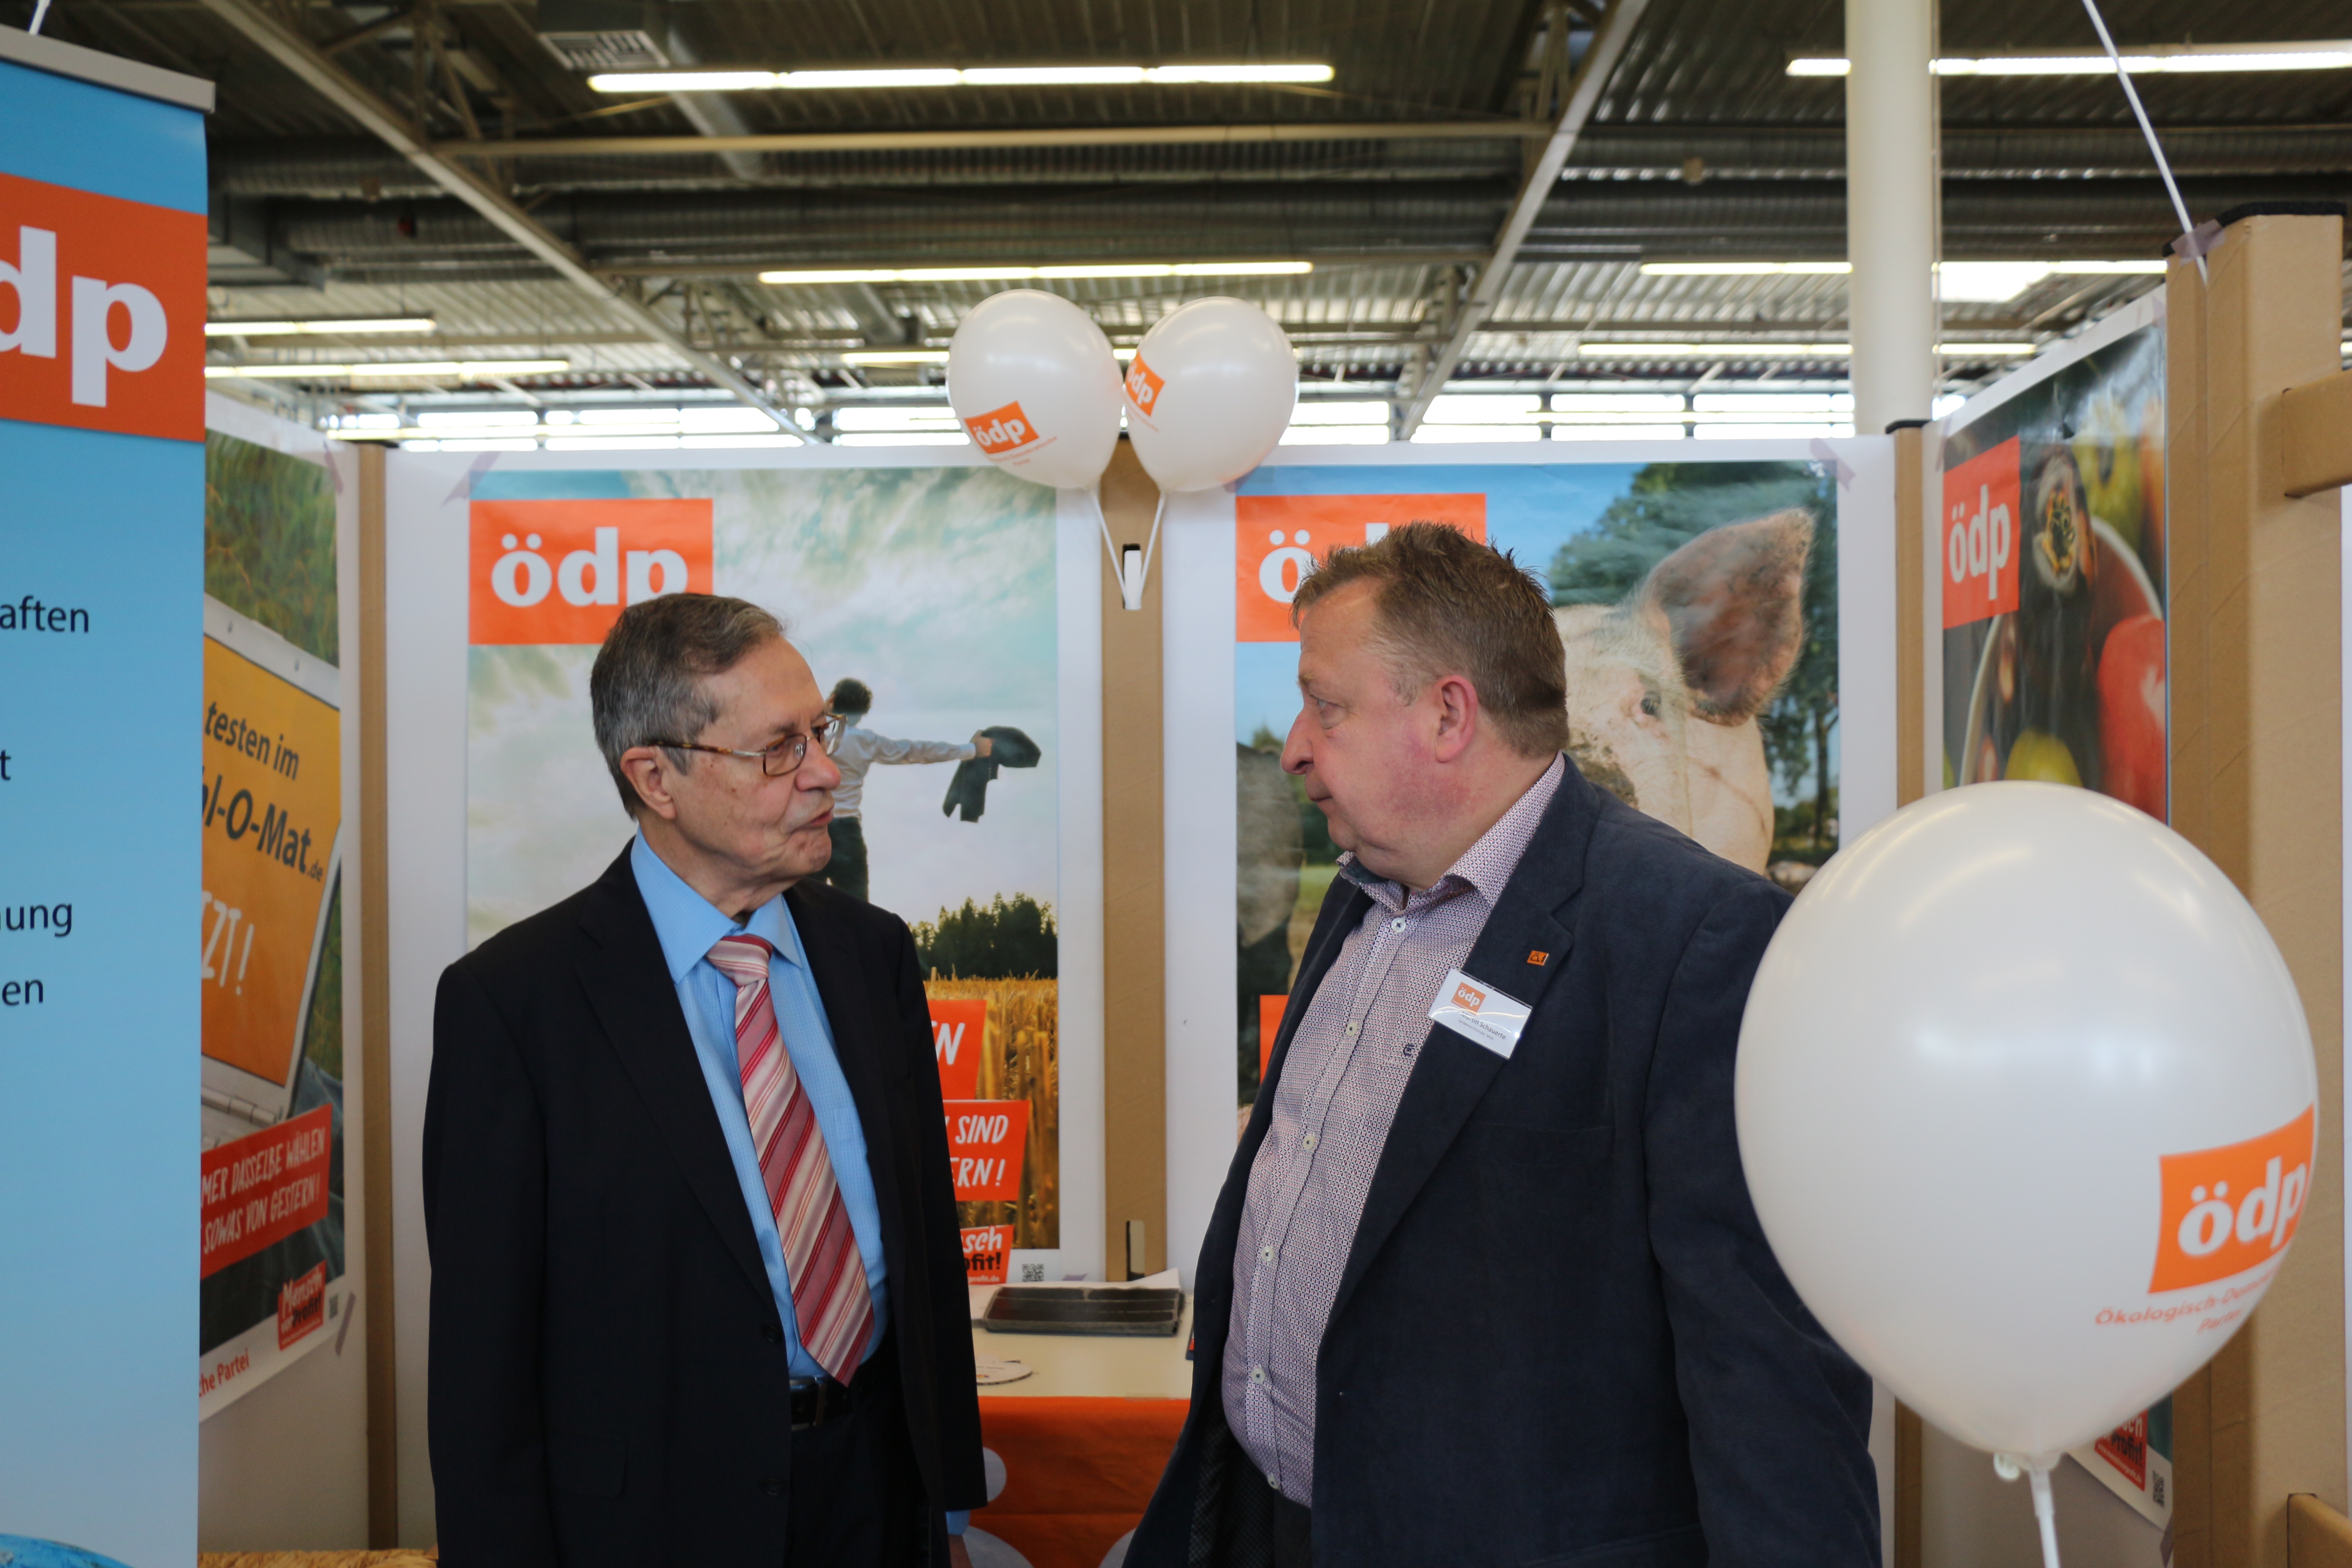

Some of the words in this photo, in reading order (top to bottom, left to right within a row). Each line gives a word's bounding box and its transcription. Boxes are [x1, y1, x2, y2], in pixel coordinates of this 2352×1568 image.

[973, 418, 1026, 445] ödp
[1950, 484, 2011, 600] ödp
[491, 526, 688, 607] ödp
[0, 595, 89, 632] aften
[205, 701, 270, 765] testen
[273, 733, 299, 780] im
[0, 903, 72, 937] ung
[1458, 987, 1480, 1007] ödp
[1461, 1011, 1479, 1025] Martin
[1479, 1021, 1506, 1040] Schauerte
[955, 1114, 1009, 1144] SIND
[231, 1143, 284, 1195] DASSELBE
[204, 1208, 243, 1254] SOWAS
[246, 1196, 268, 1235] VON
[2177, 1155, 2307, 1257] ödp
[217, 1347, 250, 1386] Partei
